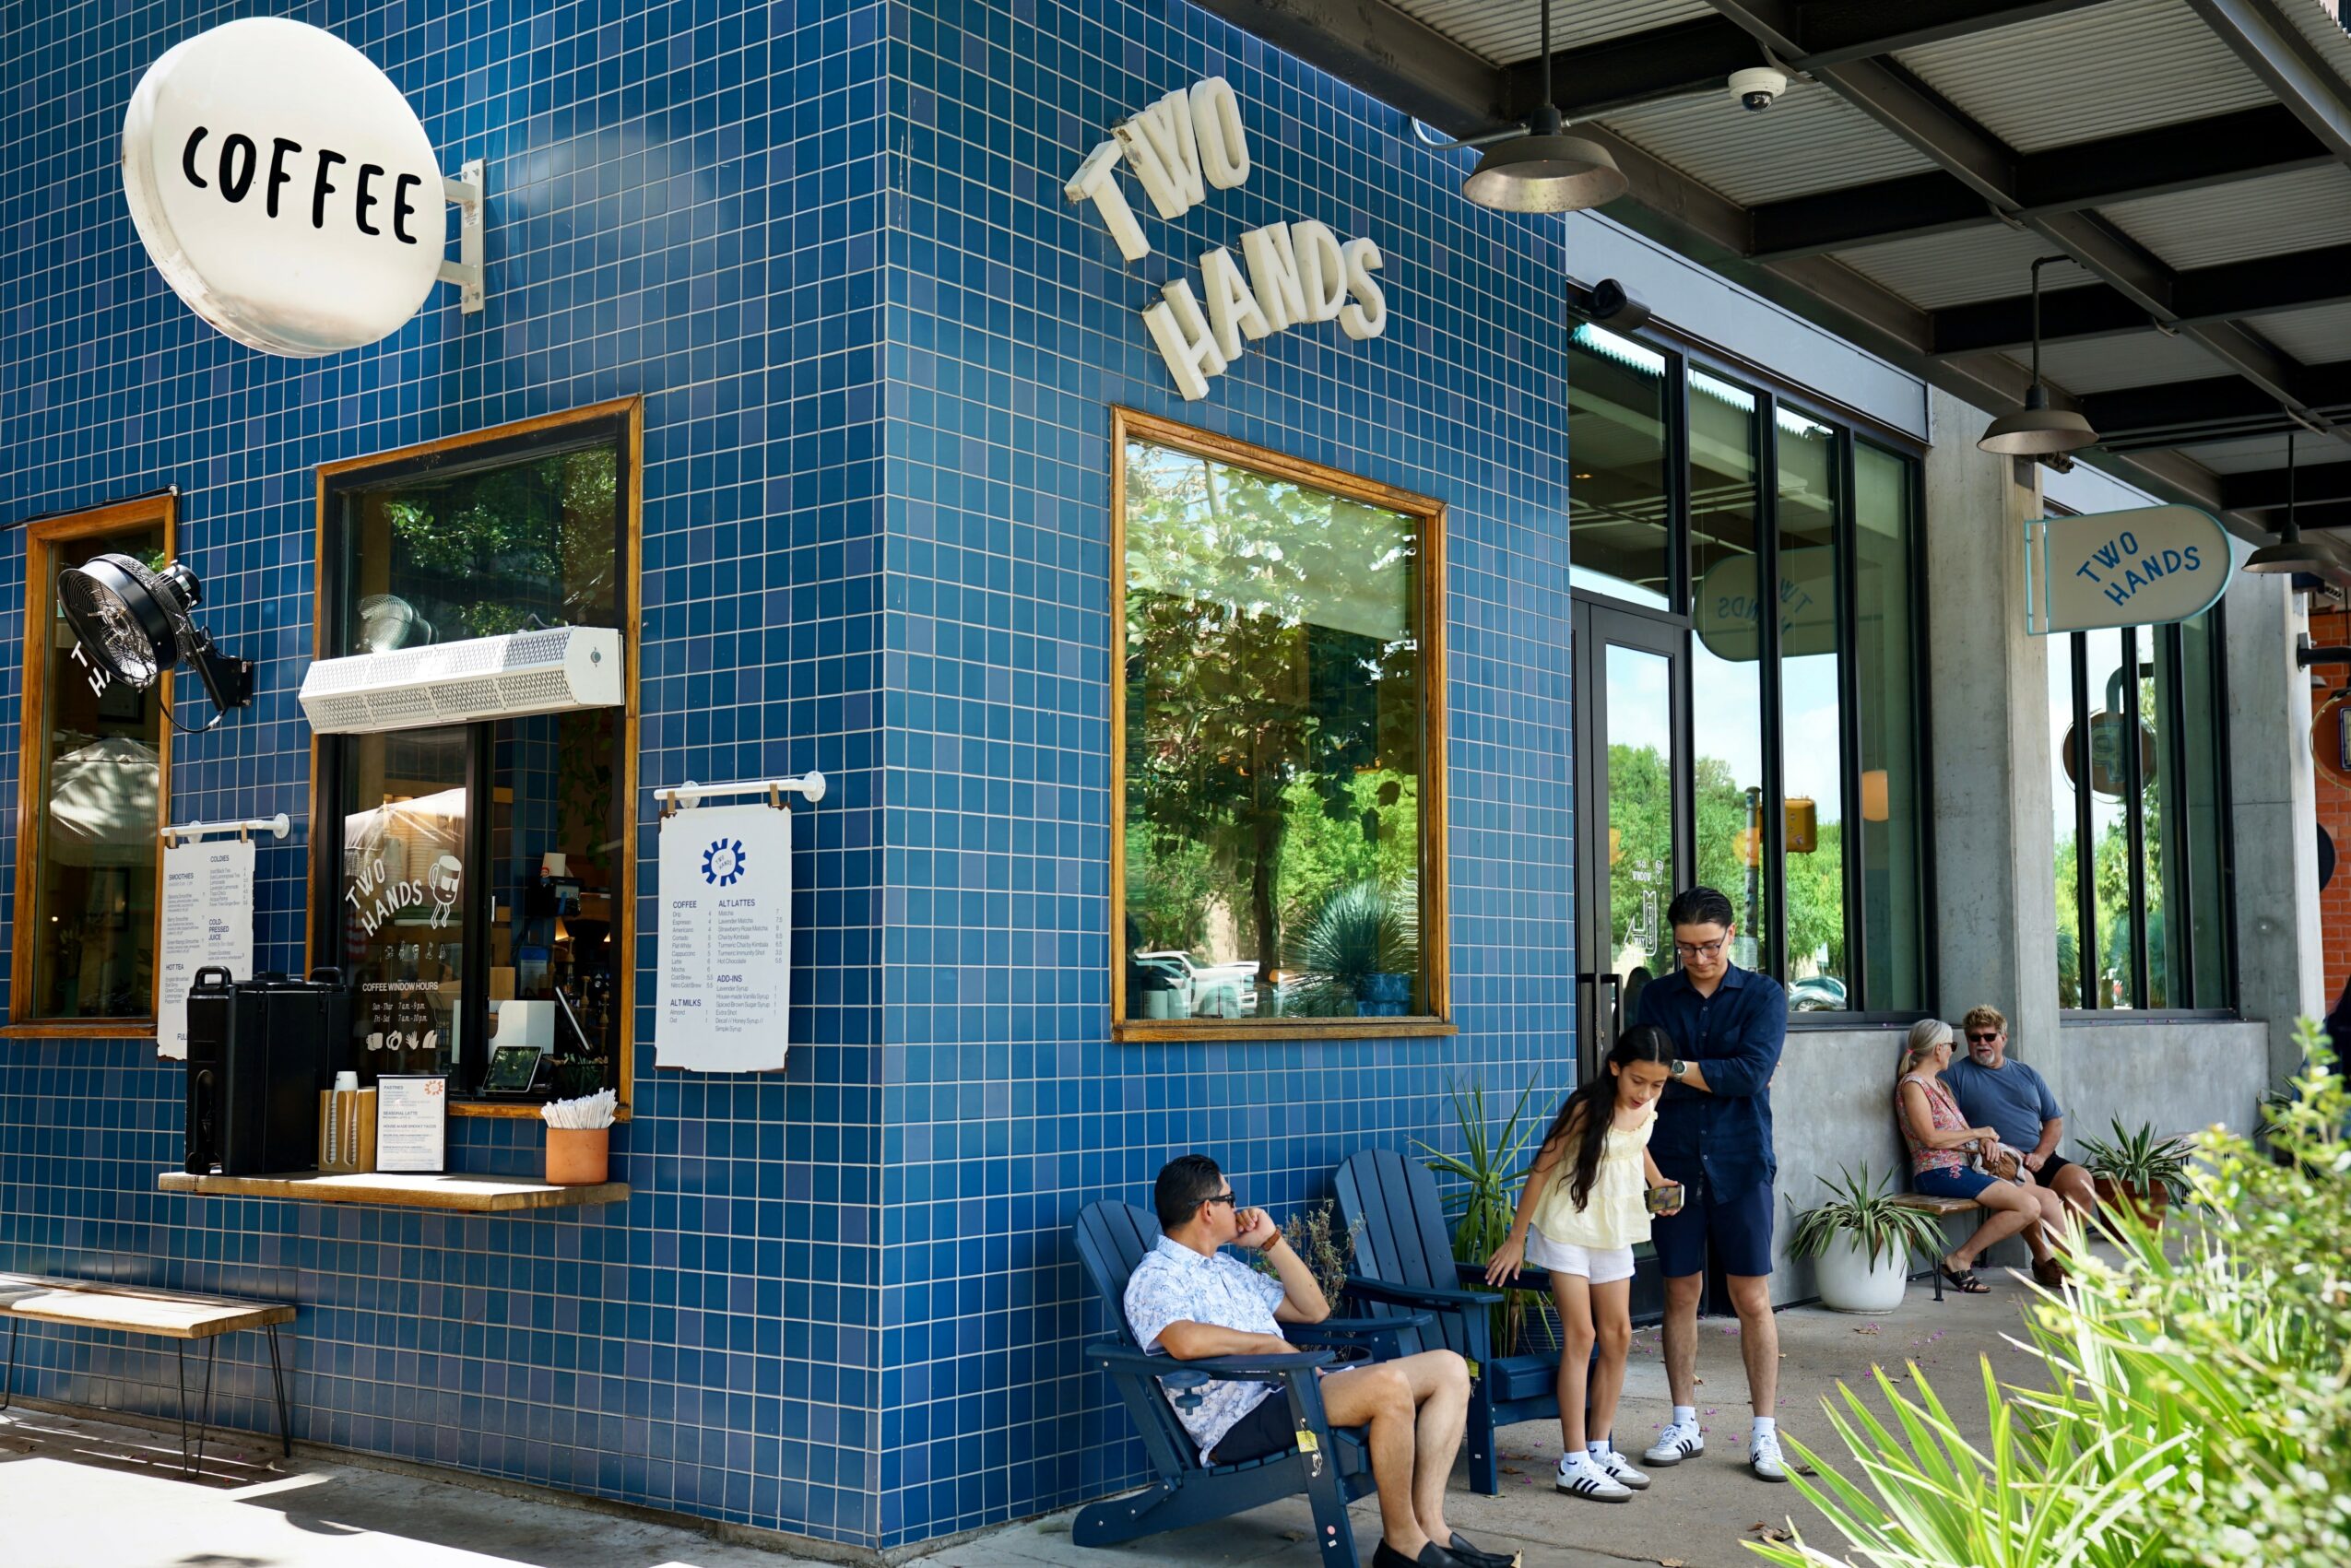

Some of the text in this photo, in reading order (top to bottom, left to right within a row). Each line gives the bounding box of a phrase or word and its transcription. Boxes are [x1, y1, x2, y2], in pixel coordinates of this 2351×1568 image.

[1064, 77, 1250, 261] TWO
[183, 125, 422, 244] COFFEE
[1141, 219, 1387, 401] HANDS
[2076, 531, 2138, 583] TWO
[2104, 546, 2200, 607] HANDS
[346, 859, 384, 910] TWO
[361, 879, 423, 937] HANDS
[673, 901, 697, 909] COFFEE
[719, 899, 756, 908] ALT LATTES
[1634, 937, 1645, 947] WAY
[362, 982, 439, 992] COFFEE WINDOW HOURS
[717, 974, 742, 983] ADD-INS
[398, 1001, 401, 1009] 7
[398, 1014, 401, 1022] 7
